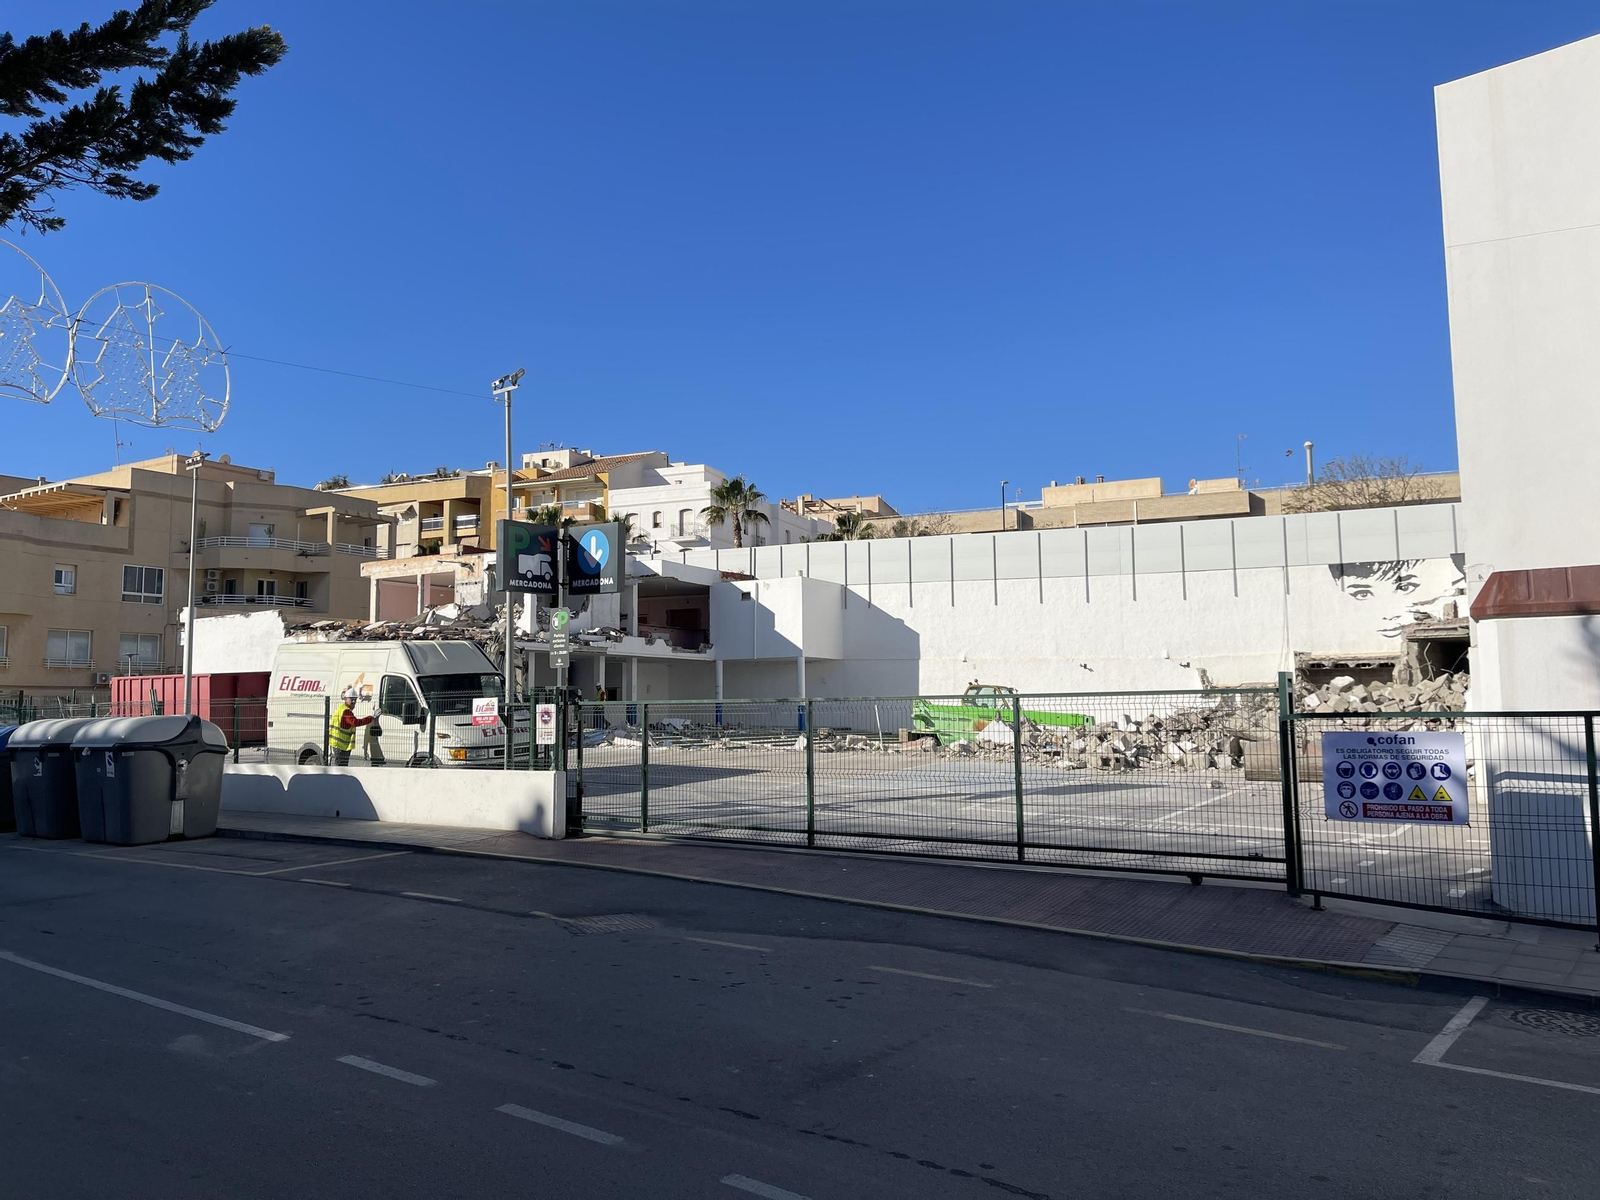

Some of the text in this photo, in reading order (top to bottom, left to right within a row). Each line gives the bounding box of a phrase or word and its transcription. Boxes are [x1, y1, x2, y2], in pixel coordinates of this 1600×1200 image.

[508, 526, 531, 558] P
[509, 579, 552, 589] MERCADONA
[572, 577, 614, 587] MERCADONA
[1377, 734, 1416, 745] cofan
[1366, 804, 1398, 812] PROHIBIDO
[1431, 806, 1448, 814] TODA
[1367, 810, 1395, 818] PERSONA
